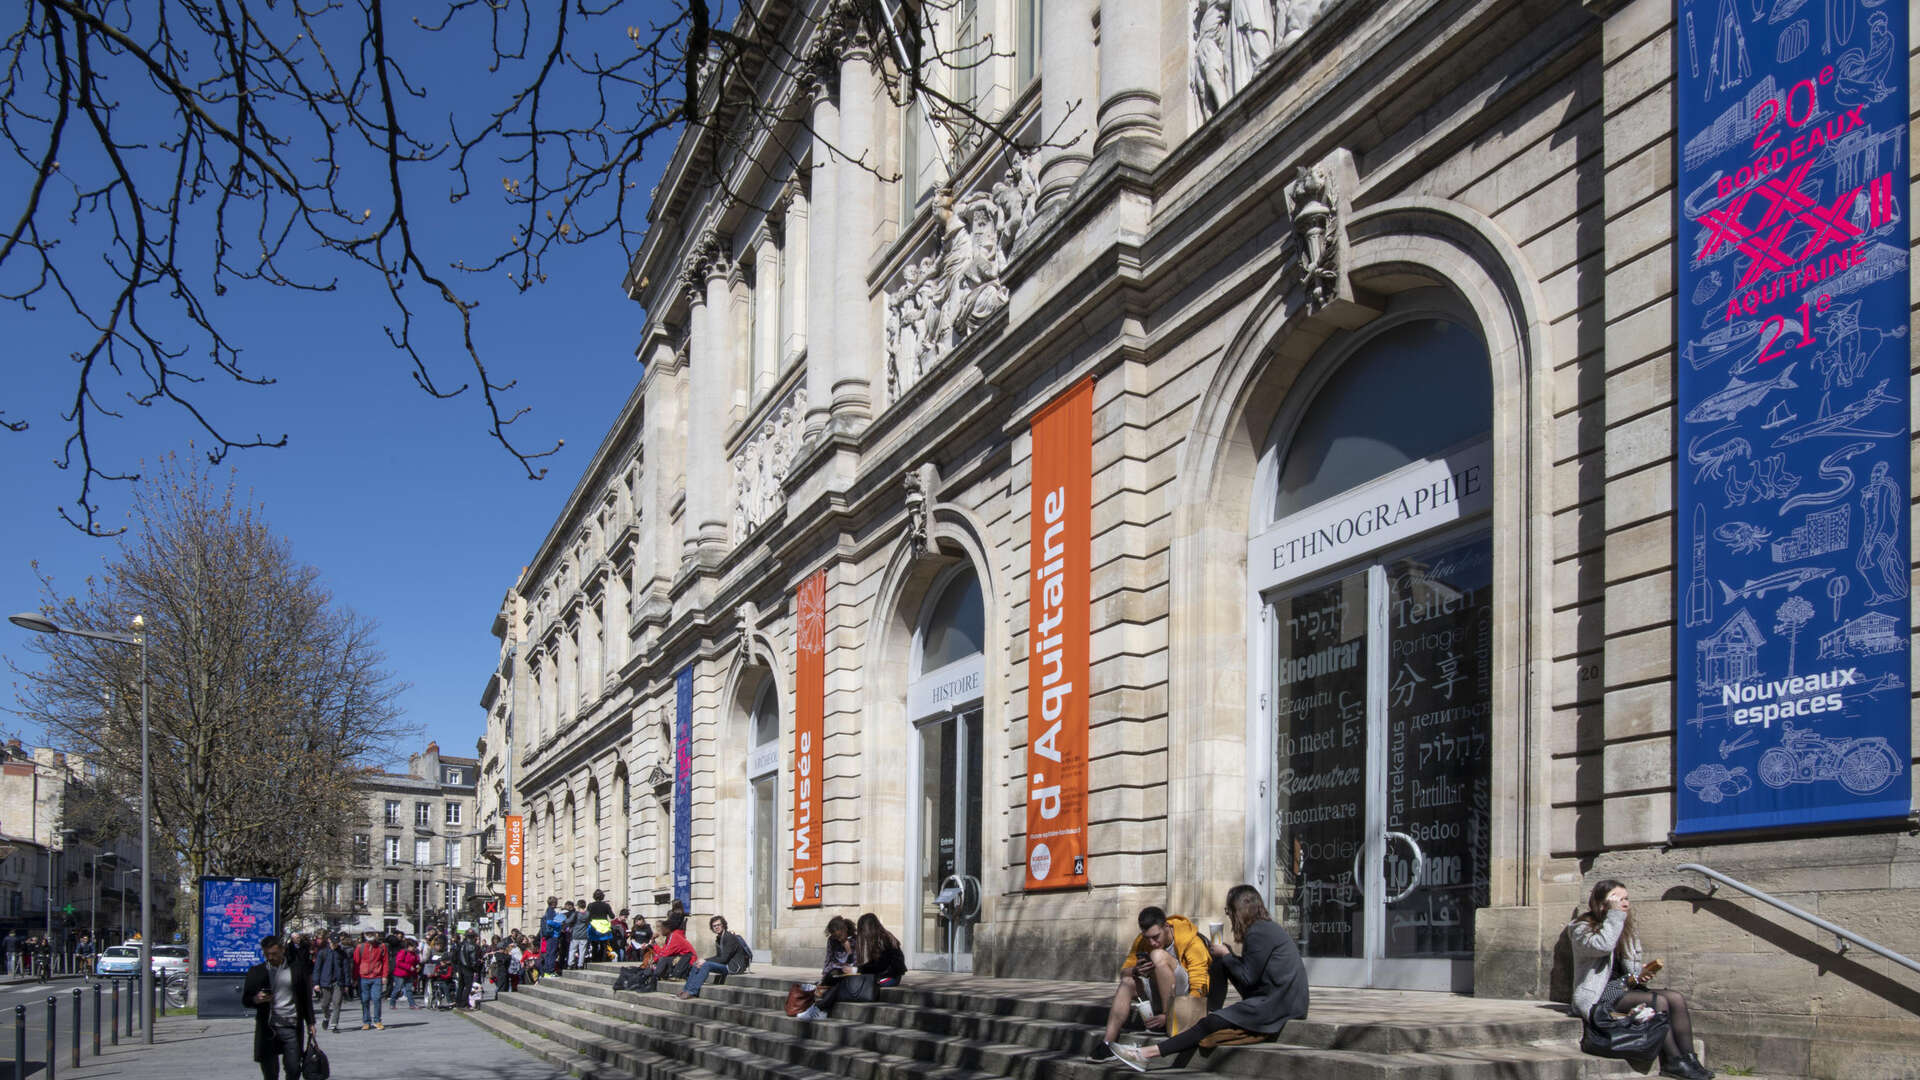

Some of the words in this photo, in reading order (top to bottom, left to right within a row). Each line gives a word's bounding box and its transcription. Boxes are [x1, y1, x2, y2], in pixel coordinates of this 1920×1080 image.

[1718, 104, 1865, 199] BORDEAUX
[1725, 241, 1868, 322] AQUITAINE
[1272, 464, 1482, 570] ETHNOGRAPHIE
[1392, 587, 1476, 629] Teilen
[1032, 485, 1073, 821] d'Aquitaine
[1392, 627, 1471, 659] Partager
[1279, 640, 1361, 686] Encontrar
[1390, 651, 1469, 708] 分享
[1582, 665, 1600, 681] 20
[932, 671, 979, 704] HISTOIRE
[1722, 666, 1857, 706] Nouveaux
[1410, 700, 1491, 736] делиться
[1734, 692, 1843, 728] espaces
[1279, 732, 1295, 758] To
[1299, 727, 1336, 754] meet
[1278, 763, 1361, 797] Rencontrer
[1389, 720, 1405, 828] Partekatus
[1412, 775, 1466, 809] Partilhar
[796, 731, 811, 861] Musée
[510, 820, 521, 854] Musée
[1410, 820, 1460, 841] Sedoo
[1389, 854, 1408, 888] To
[1411, 852, 1462, 887] share
[1297, 870, 1359, 907] 相遇
